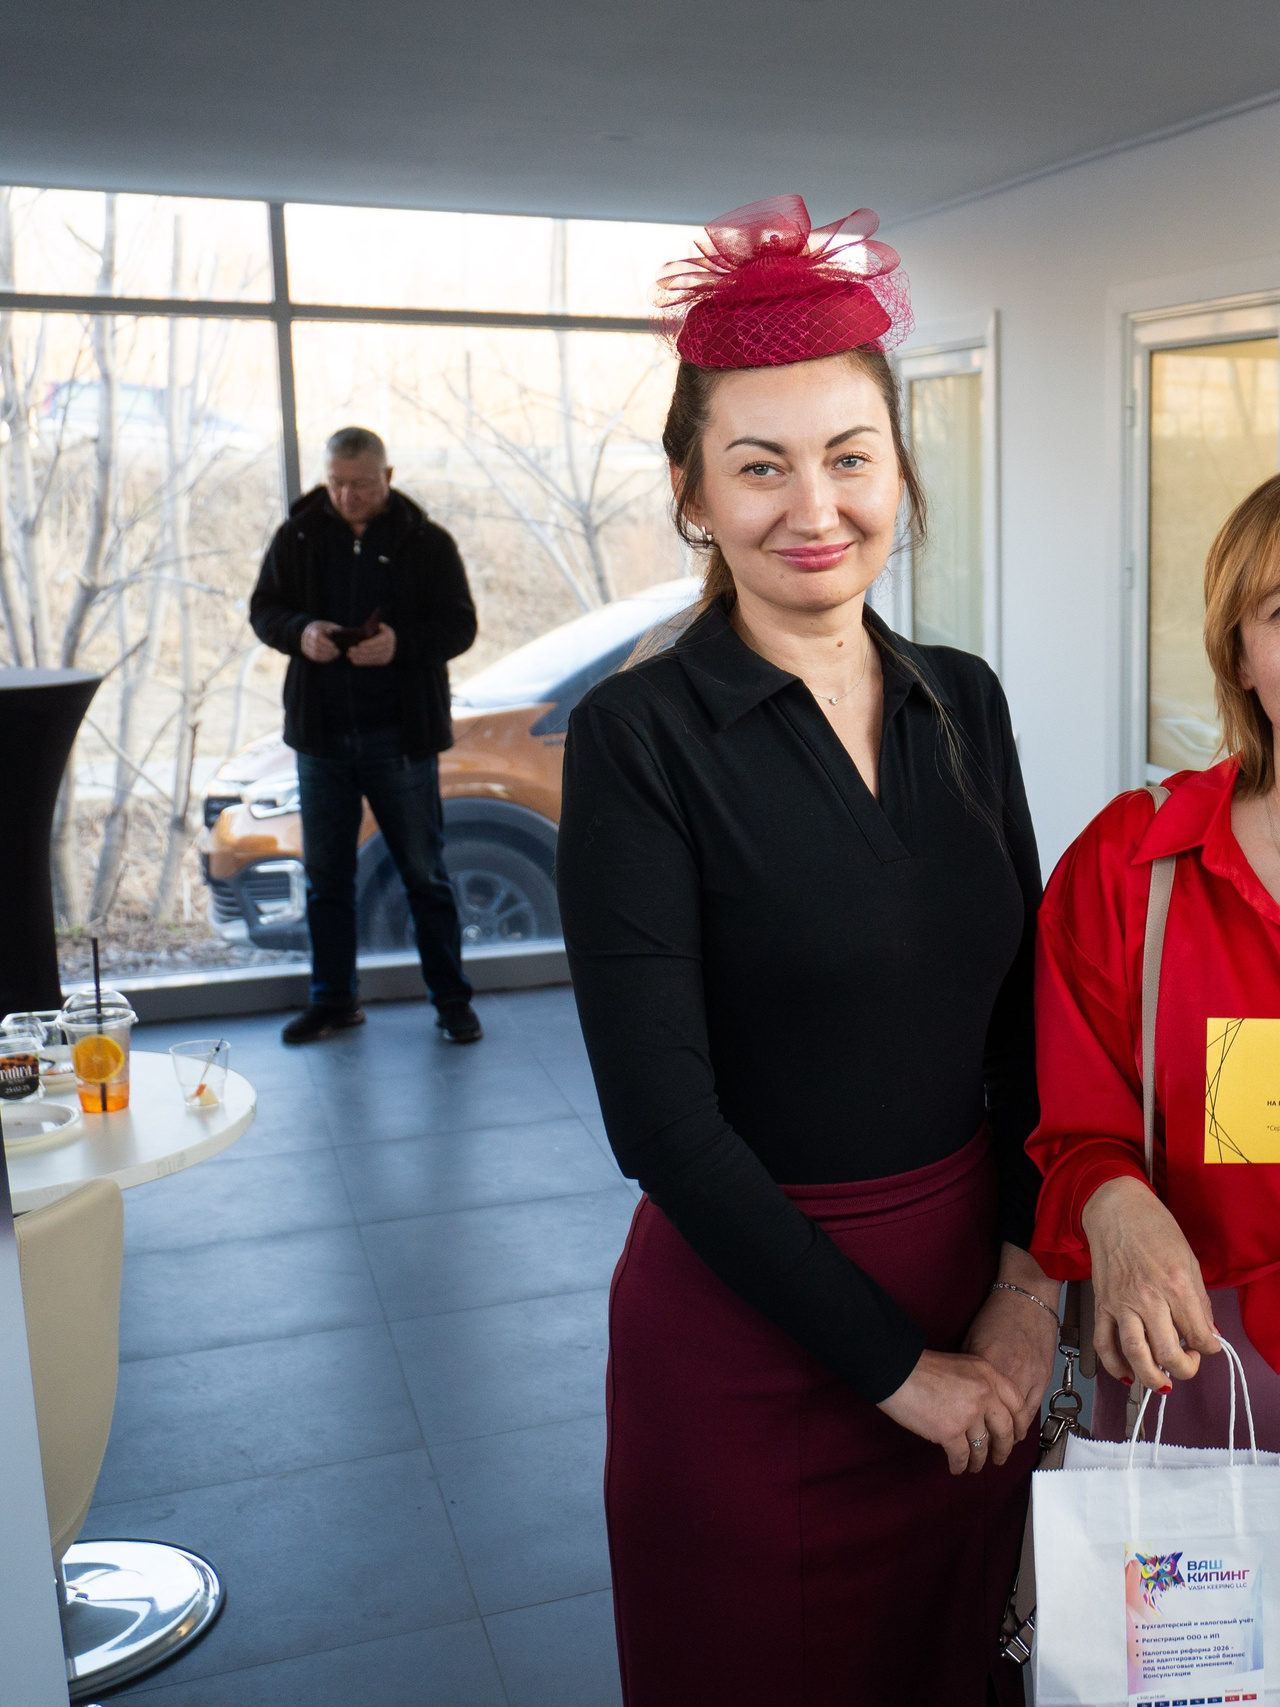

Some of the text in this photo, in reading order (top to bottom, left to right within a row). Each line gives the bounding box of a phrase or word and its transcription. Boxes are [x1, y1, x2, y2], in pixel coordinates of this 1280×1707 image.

[1187, 1560, 1223, 1571] ВАШ
[1187, 1569, 1250, 1583] КИПИНГ
[1141, 1621, 1192, 1630] Бухгалтерский
[1200, 1617, 1238, 1625] налоговый
[1141, 1635, 1185, 1643] Регистрация
[1180, 1646, 1211, 1655] реформа
[1143, 1671, 1191, 1680] Консультации
